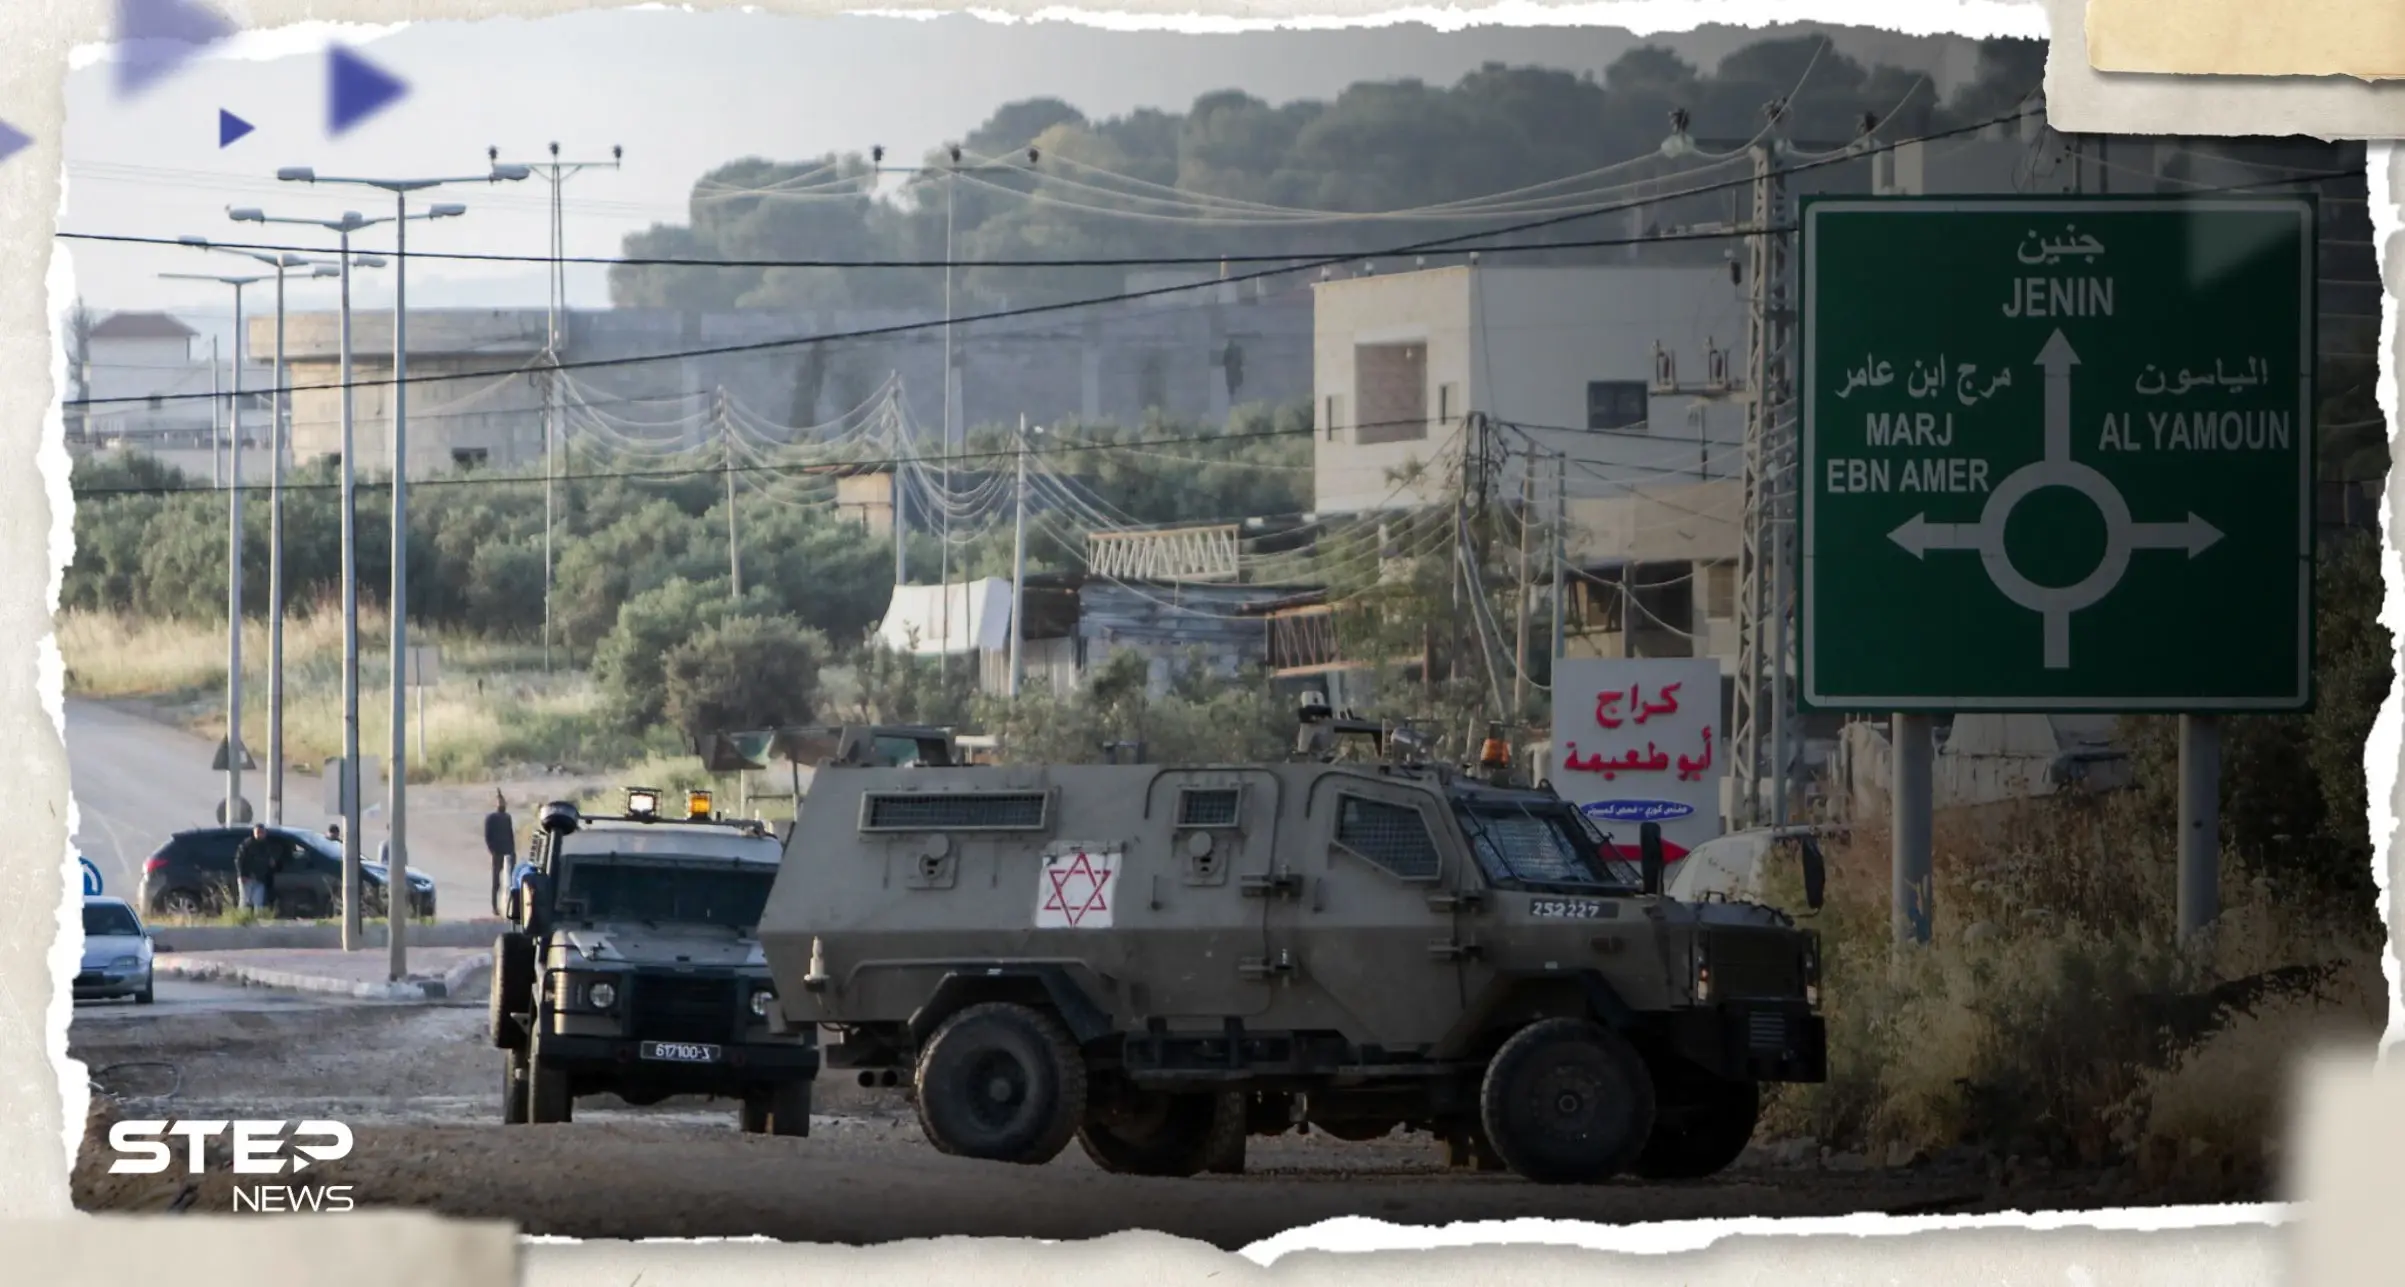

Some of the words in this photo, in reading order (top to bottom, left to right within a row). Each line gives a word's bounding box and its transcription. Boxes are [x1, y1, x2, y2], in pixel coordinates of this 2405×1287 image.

[2017, 223, 2104, 264] جنين
[2002, 276, 2114, 318] JENIN
[1835, 352, 1895, 398] عامر
[1907, 353, 1946, 398] ابن
[1957, 363, 2012, 406] مرج
[1866, 412, 1953, 447] MARJ
[2098, 412, 2141, 451] AL
[2147, 410, 2290, 451] YAMOUN
[1827, 458, 1890, 493] EBN
[1899, 458, 1989, 493] AMER
[1595, 683, 1682, 728] كراج
[1564, 741, 1669, 780] طعيمة
[1677, 725, 1712, 781] أبو
[1532, 902, 1600, 917] 252227
